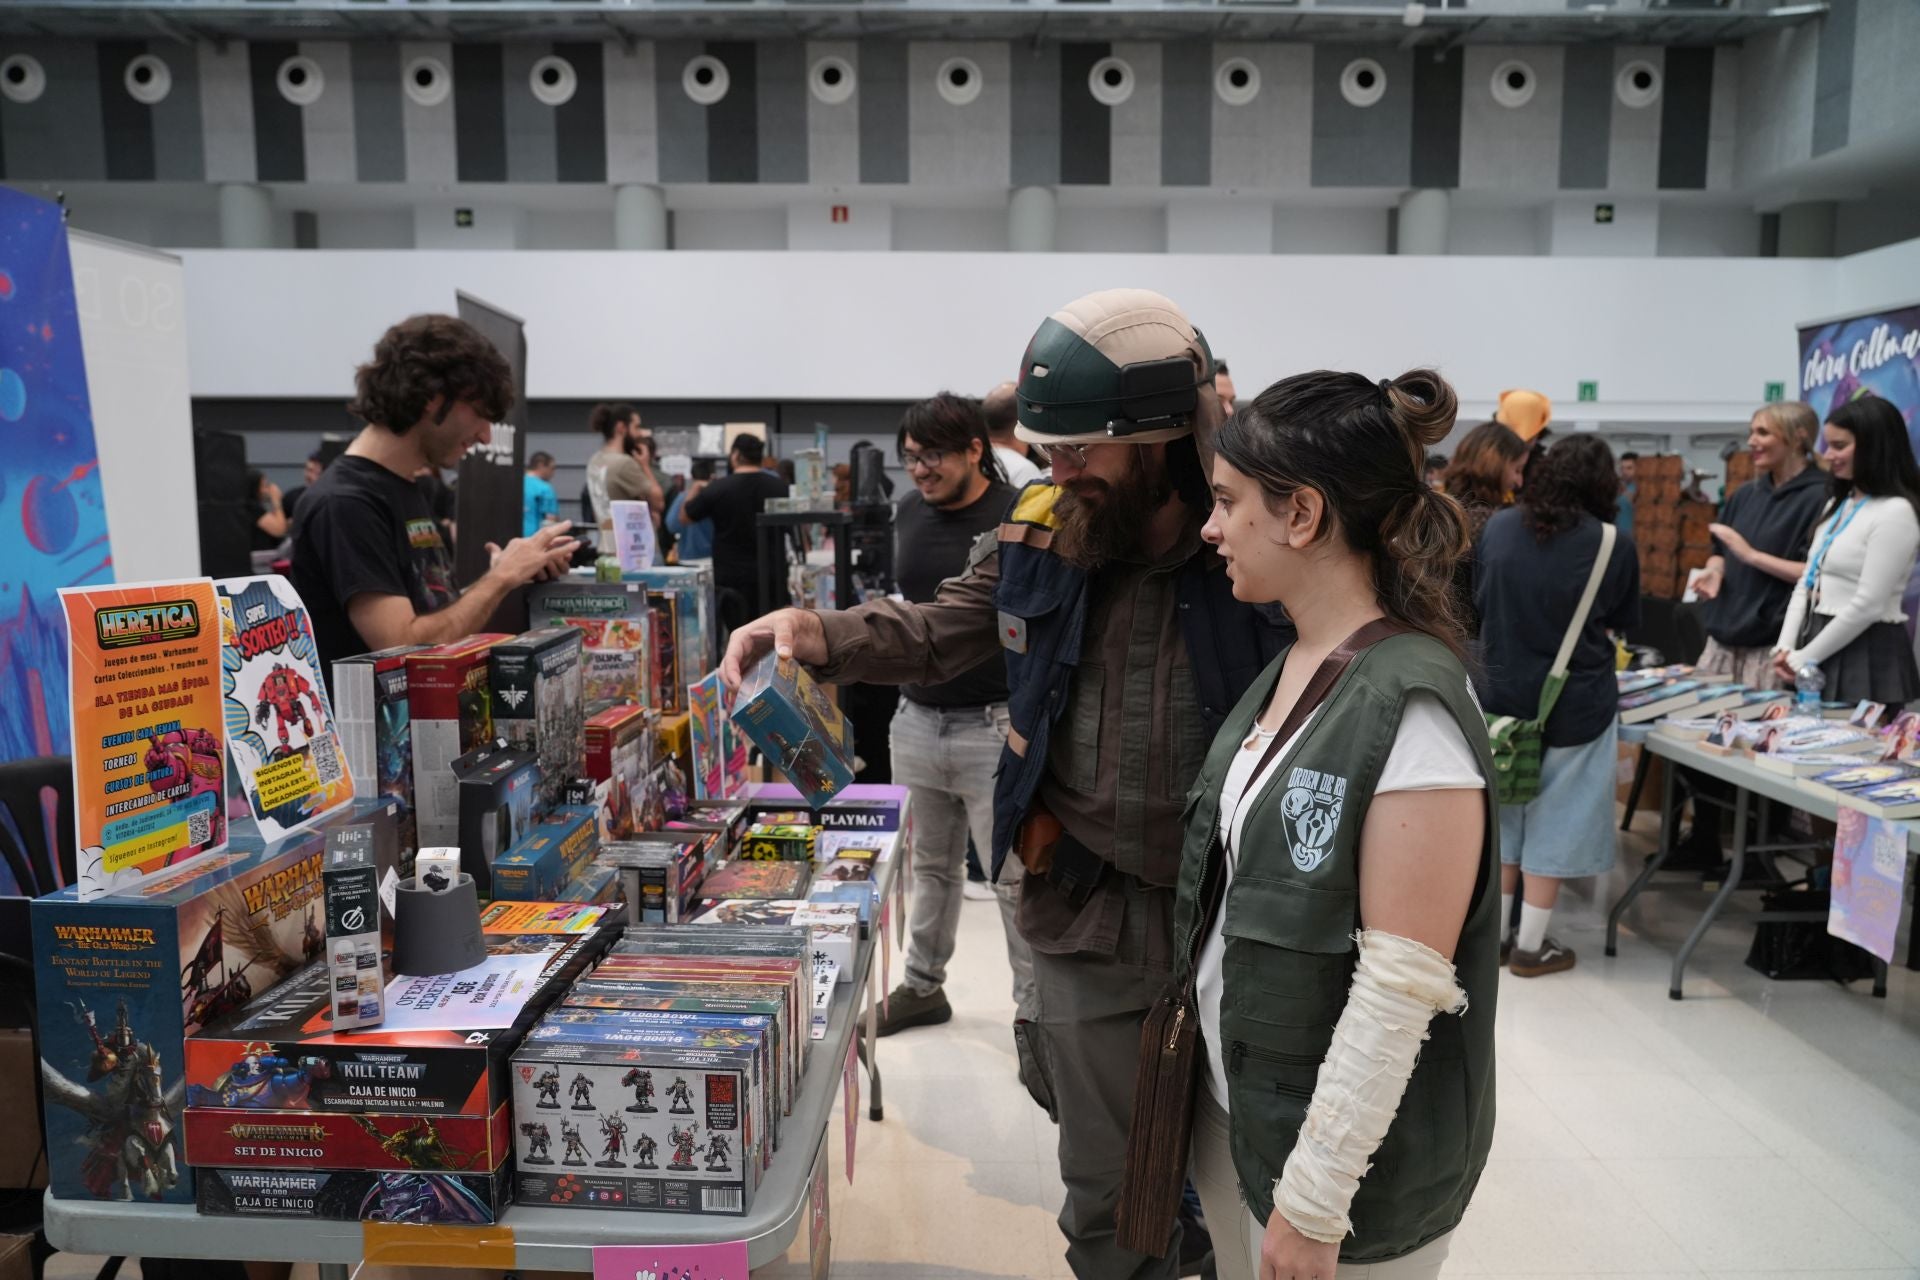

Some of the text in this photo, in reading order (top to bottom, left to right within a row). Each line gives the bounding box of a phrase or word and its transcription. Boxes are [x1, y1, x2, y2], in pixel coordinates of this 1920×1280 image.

[100, 605, 195, 637] HERETICA
[245, 604, 268, 624] SUPER
[240, 617, 288, 658] SORTEO
[104, 646, 199, 668] Juegos de mesa Warhammer
[94, 673, 116, 684] Cartas
[117, 665, 165, 680] Coleccionables
[176, 660, 195, 670] mucho
[116, 686, 156, 703] TIENDA
[119, 706, 133, 719] DE
[136, 704, 149, 716] LA
[102, 720, 181, 748] EVENTOS CADA SEMANA
[104, 753, 137, 771] TORNEOS
[105, 765, 174, 794] CURSOS DE PINTURA
[259, 768, 302, 787] INSTAGRAM
[268, 782, 290, 795] GANA
[290, 776, 307, 785] ESTE
[1319, 773, 1335, 793] DE
[106, 792, 156, 817] INTERCAMBIO
[157, 790, 167, 801] DE
[167, 783, 190, 799] CARTAS
[820, 813, 886, 827] PLAYMAT
[242, 853, 324, 916] WARHAM
[54, 926, 157, 944] WARHAMMER
[92, 941, 109, 949] OLD
[111, 941, 137, 951] WORLD
[413, 972, 457, 1010] HERETIC
[450, 981, 478, 995] 45€
[344, 1064, 419, 1079] KILL TEAM
[349, 1085, 416, 1098] CAJA DE INICIO
[324, 1098, 363, 1106] ESCARAMUZAS
[231, 1124, 325, 1140] WARHAMMER
[234, 1147, 324, 1157] SET DE INICIO
[231, 1175, 317, 1190] WARHAMMER
[235, 1197, 314, 1209] CAJA DE INICIO
